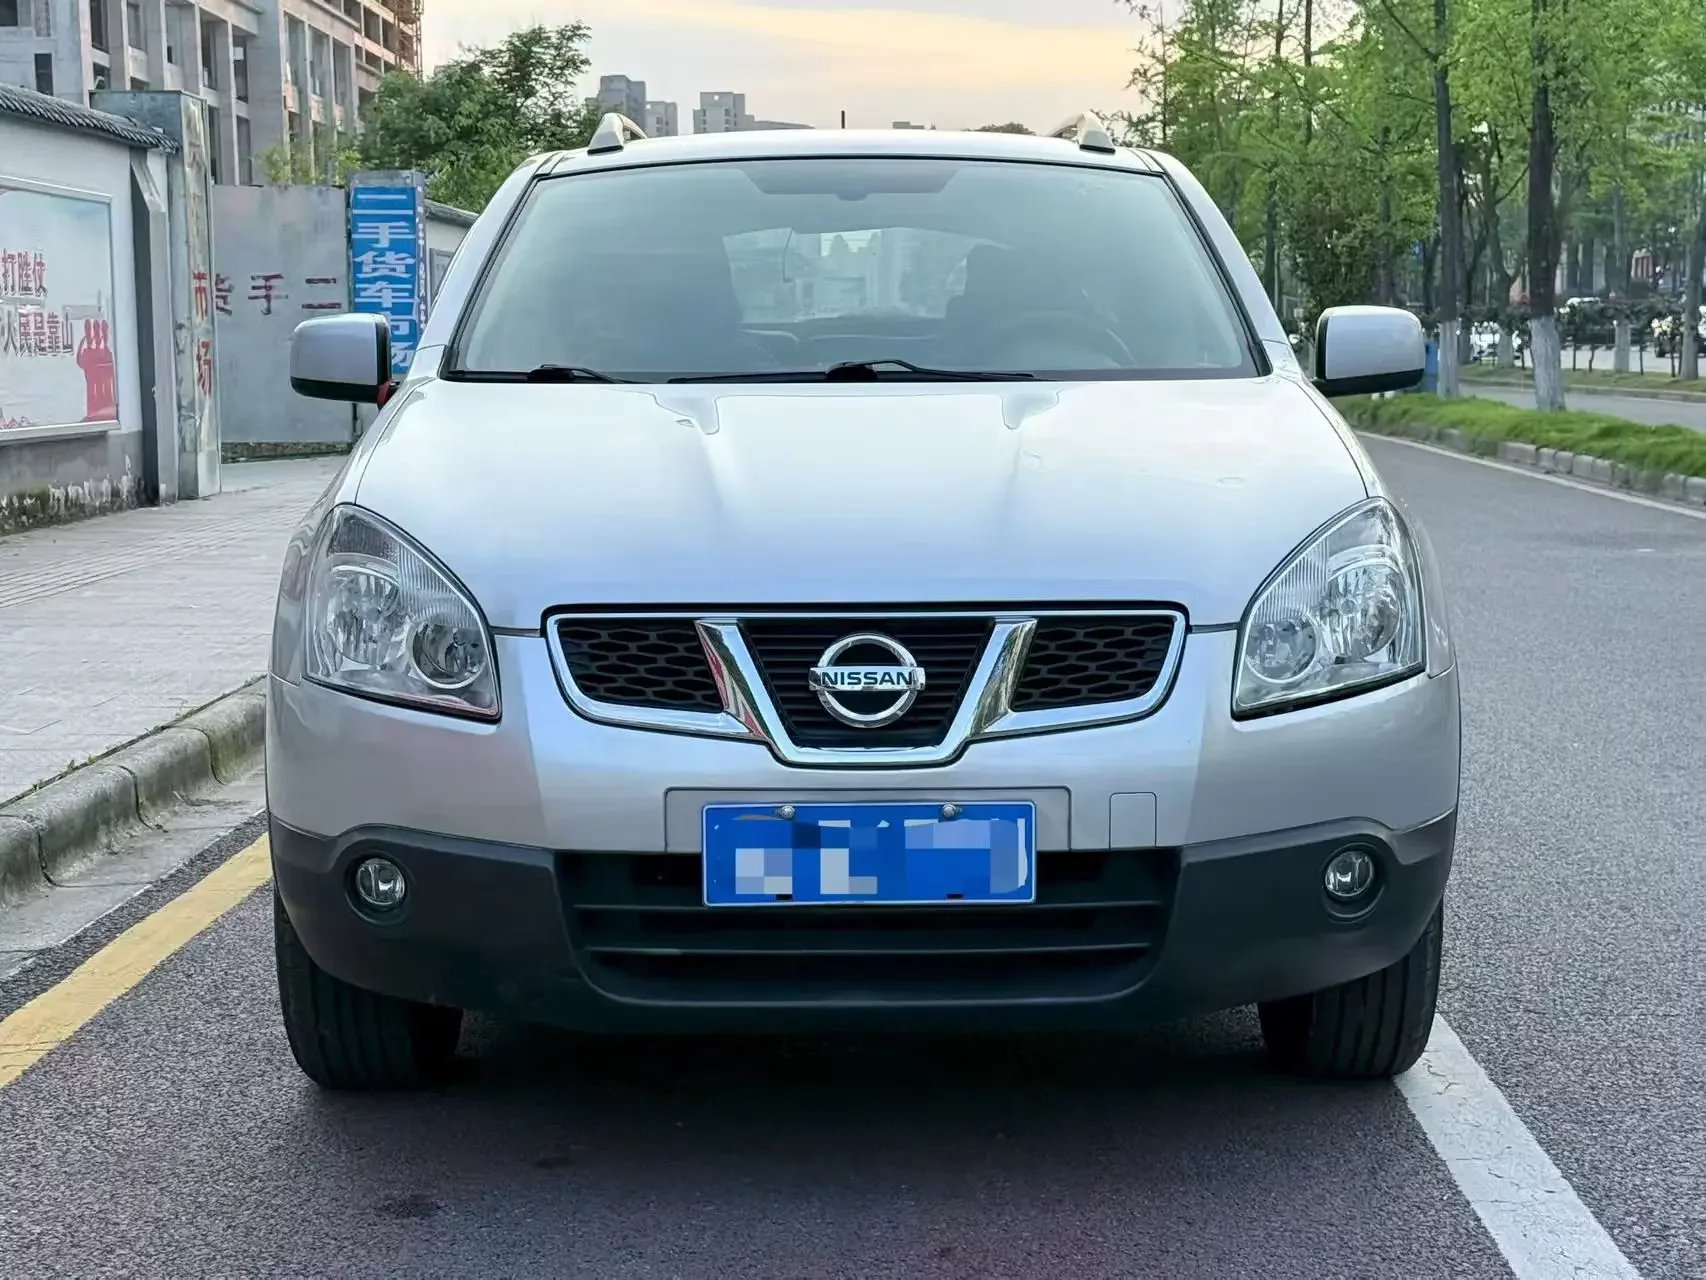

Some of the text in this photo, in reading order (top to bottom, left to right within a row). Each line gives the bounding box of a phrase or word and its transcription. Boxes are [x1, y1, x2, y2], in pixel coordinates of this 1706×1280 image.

[0, 248, 47, 297] 打胜仗
[821, 671, 913, 686] NISSAN
